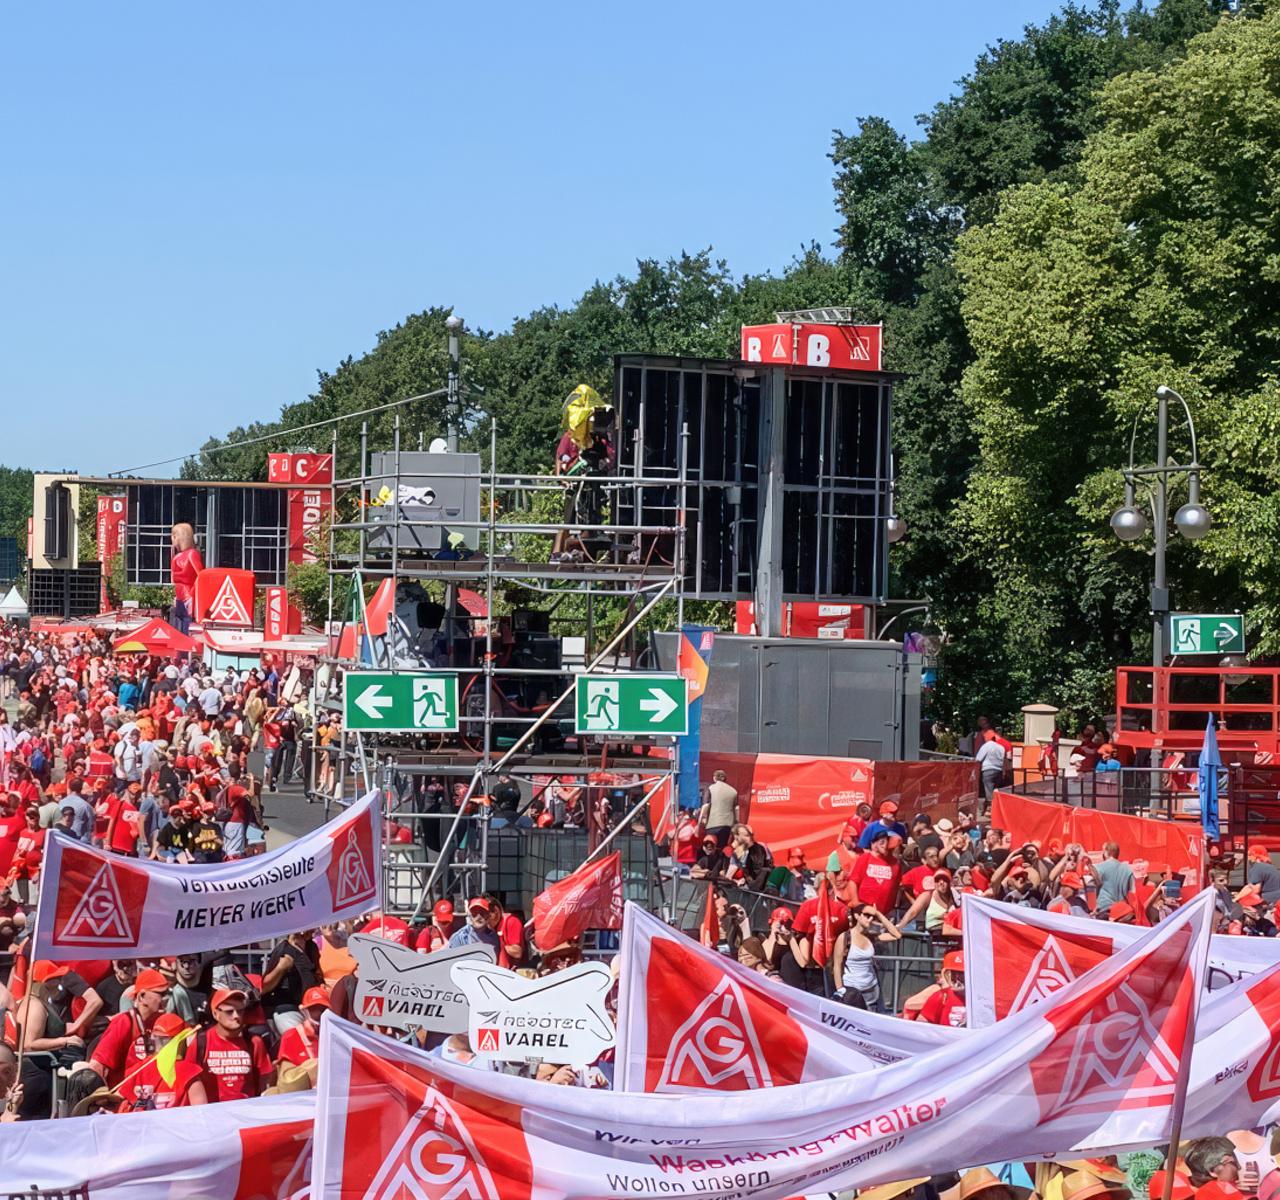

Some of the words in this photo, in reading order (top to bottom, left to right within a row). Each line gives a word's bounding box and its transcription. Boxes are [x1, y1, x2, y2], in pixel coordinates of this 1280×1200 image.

[807, 334, 830, 367] B
[175, 904, 245, 930] MEYER
[251, 886, 307, 919] WERFT
[387, 998, 445, 1018] VAREL
[505, 1032, 569, 1048] VAREL
